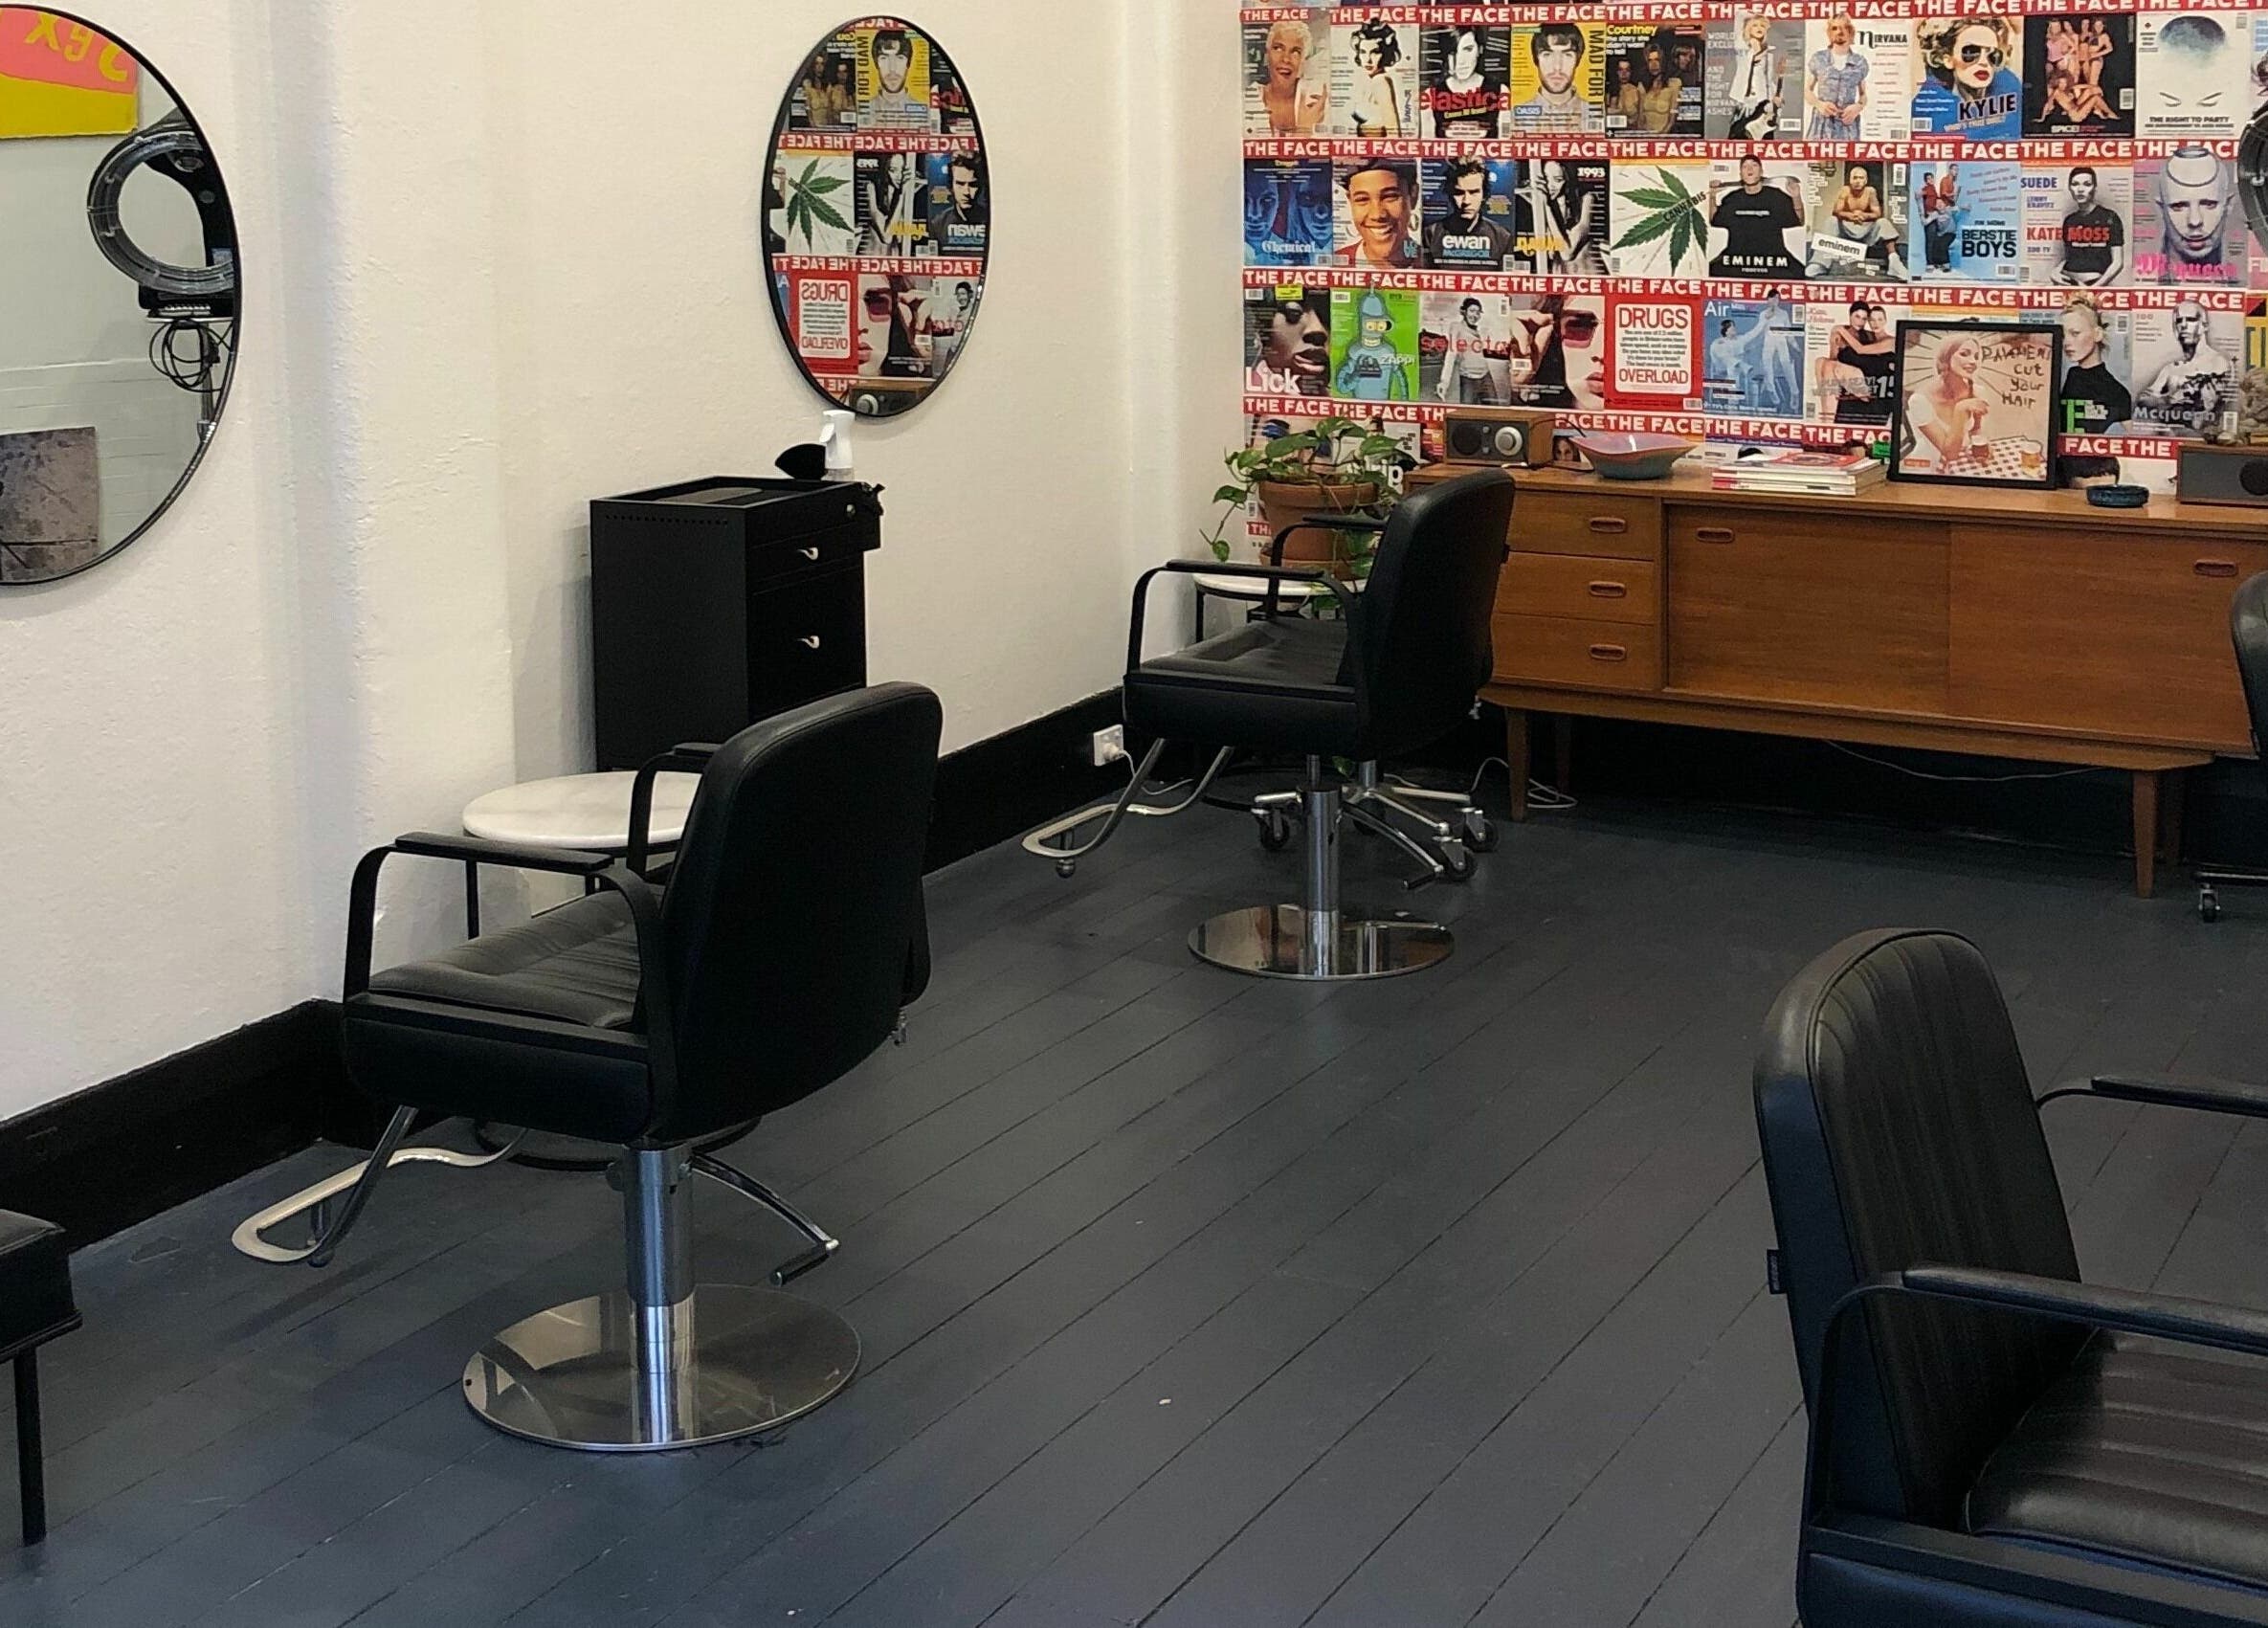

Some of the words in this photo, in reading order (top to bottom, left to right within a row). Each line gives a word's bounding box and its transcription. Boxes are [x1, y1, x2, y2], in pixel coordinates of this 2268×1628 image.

[1606, 6, 1645, 20] THE
[1651, 4, 1702, 19] FACE
[1807, 2, 1846, 17] THE
[1856, 1, 1910, 17] FACE
[1916, 0, 1957, 14] THE
[1964, 0, 2020, 13] FACE
[2026, 0, 2067, 11] THE
[2075, 0, 2134, 11] FACE
[1244, 9, 1270, 21] THE
[1273, 9, 1309, 20] FACE
[1329, 10, 1362, 23] THE
[1365, 8, 1416, 22] FACE
[1419, 9, 1456, 22] THE
[1460, 8, 1509, 22] FACE
[1513, 7, 1548, 21] THE
[1555, 6, 1605, 20] FACE
[1607, 25, 1658, 36] Courtney
[1857, 31, 1908, 49] NIRVANA
[1589, 30, 1604, 68] MAD
[1589, 69, 1604, 97] FOR
[1420, 88, 1511, 111] elastica
[1959, 93, 2016, 121] KYLIE
[1589, 101, 1604, 119] IT!
[1245, 143, 1279, 156] THE
[1283, 143, 1329, 156] FACE
[1333, 142, 1367, 155] THE
[1372, 142, 1419, 155] FACE
[1421, 143, 1456, 156] THE
[1463, 143, 1511, 157] FACE
[1515, 143, 1551, 156] THE
[1557, 143, 1608, 157] FACE
[1611, 142, 1648, 157] THE
[1655, 142, 1708, 157] FACE
[1710, 143, 1746, 157] THE
[1754, 143, 1804, 158] FACE
[1808, 144, 1848, 158] THE
[1856, 144, 1909, 158] FACE
[1912, 144, 1954, 158] THE
[1962, 144, 2019, 159] FACE
[2021, 143, 2064, 158] THE
[2072, 142, 2132, 157] FACE
[2134, 141, 2178, 157] THE
[1577, 167, 1605, 178] 1993
[2020, 177, 2057, 189] SUEDE
[1663, 191, 1706, 223] CANNABIS
[1962, 230, 2016, 240] BEASTIE
[2026, 228, 2063, 240] KATE
[2068, 227, 2110, 241] MOSS
[1442, 235, 1490, 249] ewan
[1817, 238, 1861, 256] eminem
[1962, 241, 2016, 257] BOYS
[1723, 256, 1788, 267] EMINEM
[1245, 271, 1279, 284] THE
[1283, 271, 1328, 286] FACE
[1332, 272, 1367, 285] THE
[1371, 273, 1417, 287] FACE
[1421, 275, 1456, 289] THE
[1461, 276, 1511, 290] FACE
[1511, 277, 1546, 292] THE
[1553, 278, 1602, 293] FACE
[1606, 279, 1644, 294] THE
[1650, 279, 1701, 295] FACE
[1704, 281, 1744, 298] THE
[1807, 286, 1847, 301] THE
[1854, 287, 1910, 302] FACE
[1912, 288, 1952, 303] THE
[1959, 290, 2016, 305] FACE
[2019, 291, 2063, 306] THE
[2134, 292, 2177, 306] THE
[1704, 301, 1729, 317] Air
[1618, 307, 1688, 329] DRUGS
[1245, 367, 1301, 393] Lick
[1619, 368, 1688, 384] OVERLOAD
[1247, 398, 1279, 413] THE
[1285, 400, 1331, 414] FACE
[1371, 405, 1417, 420] FACE
[1422, 407, 1456, 421] TH
[1554, 413, 1603, 429] FACE
[1606, 415, 1644, 430] THE
[1651, 417, 1703, 434] FACE
[1704, 420, 1743, 435] THE
[1749, 422, 1803, 439] FACE
[1805, 429, 1846, 444] THE
[1853, 431, 1892, 444] FAC
[2065, 437, 2123, 455] FACE
[2127, 439, 2170, 457] THE
